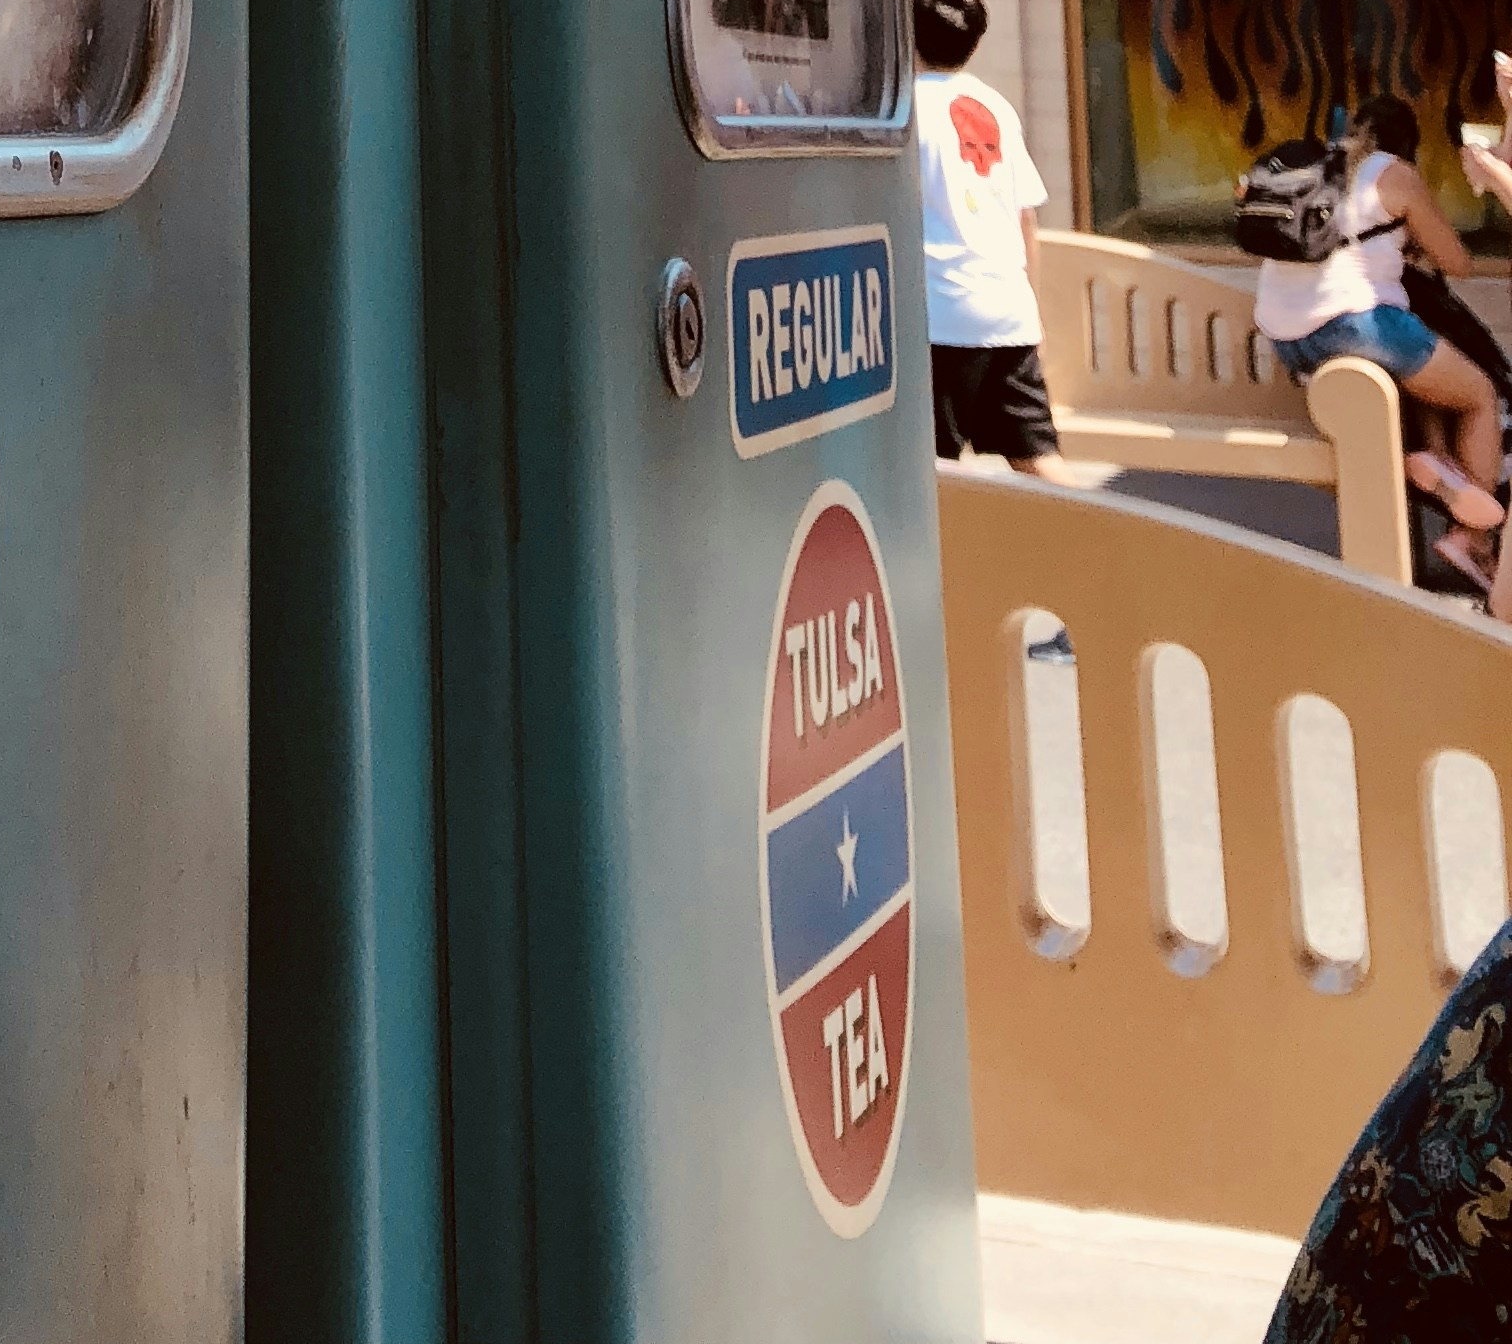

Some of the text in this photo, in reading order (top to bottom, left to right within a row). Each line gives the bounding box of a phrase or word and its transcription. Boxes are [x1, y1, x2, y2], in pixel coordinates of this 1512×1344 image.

[748, 266, 885, 404] REGULAR
[784, 591, 885, 740] TULSA
[821, 973, 888, 1141] TEA
